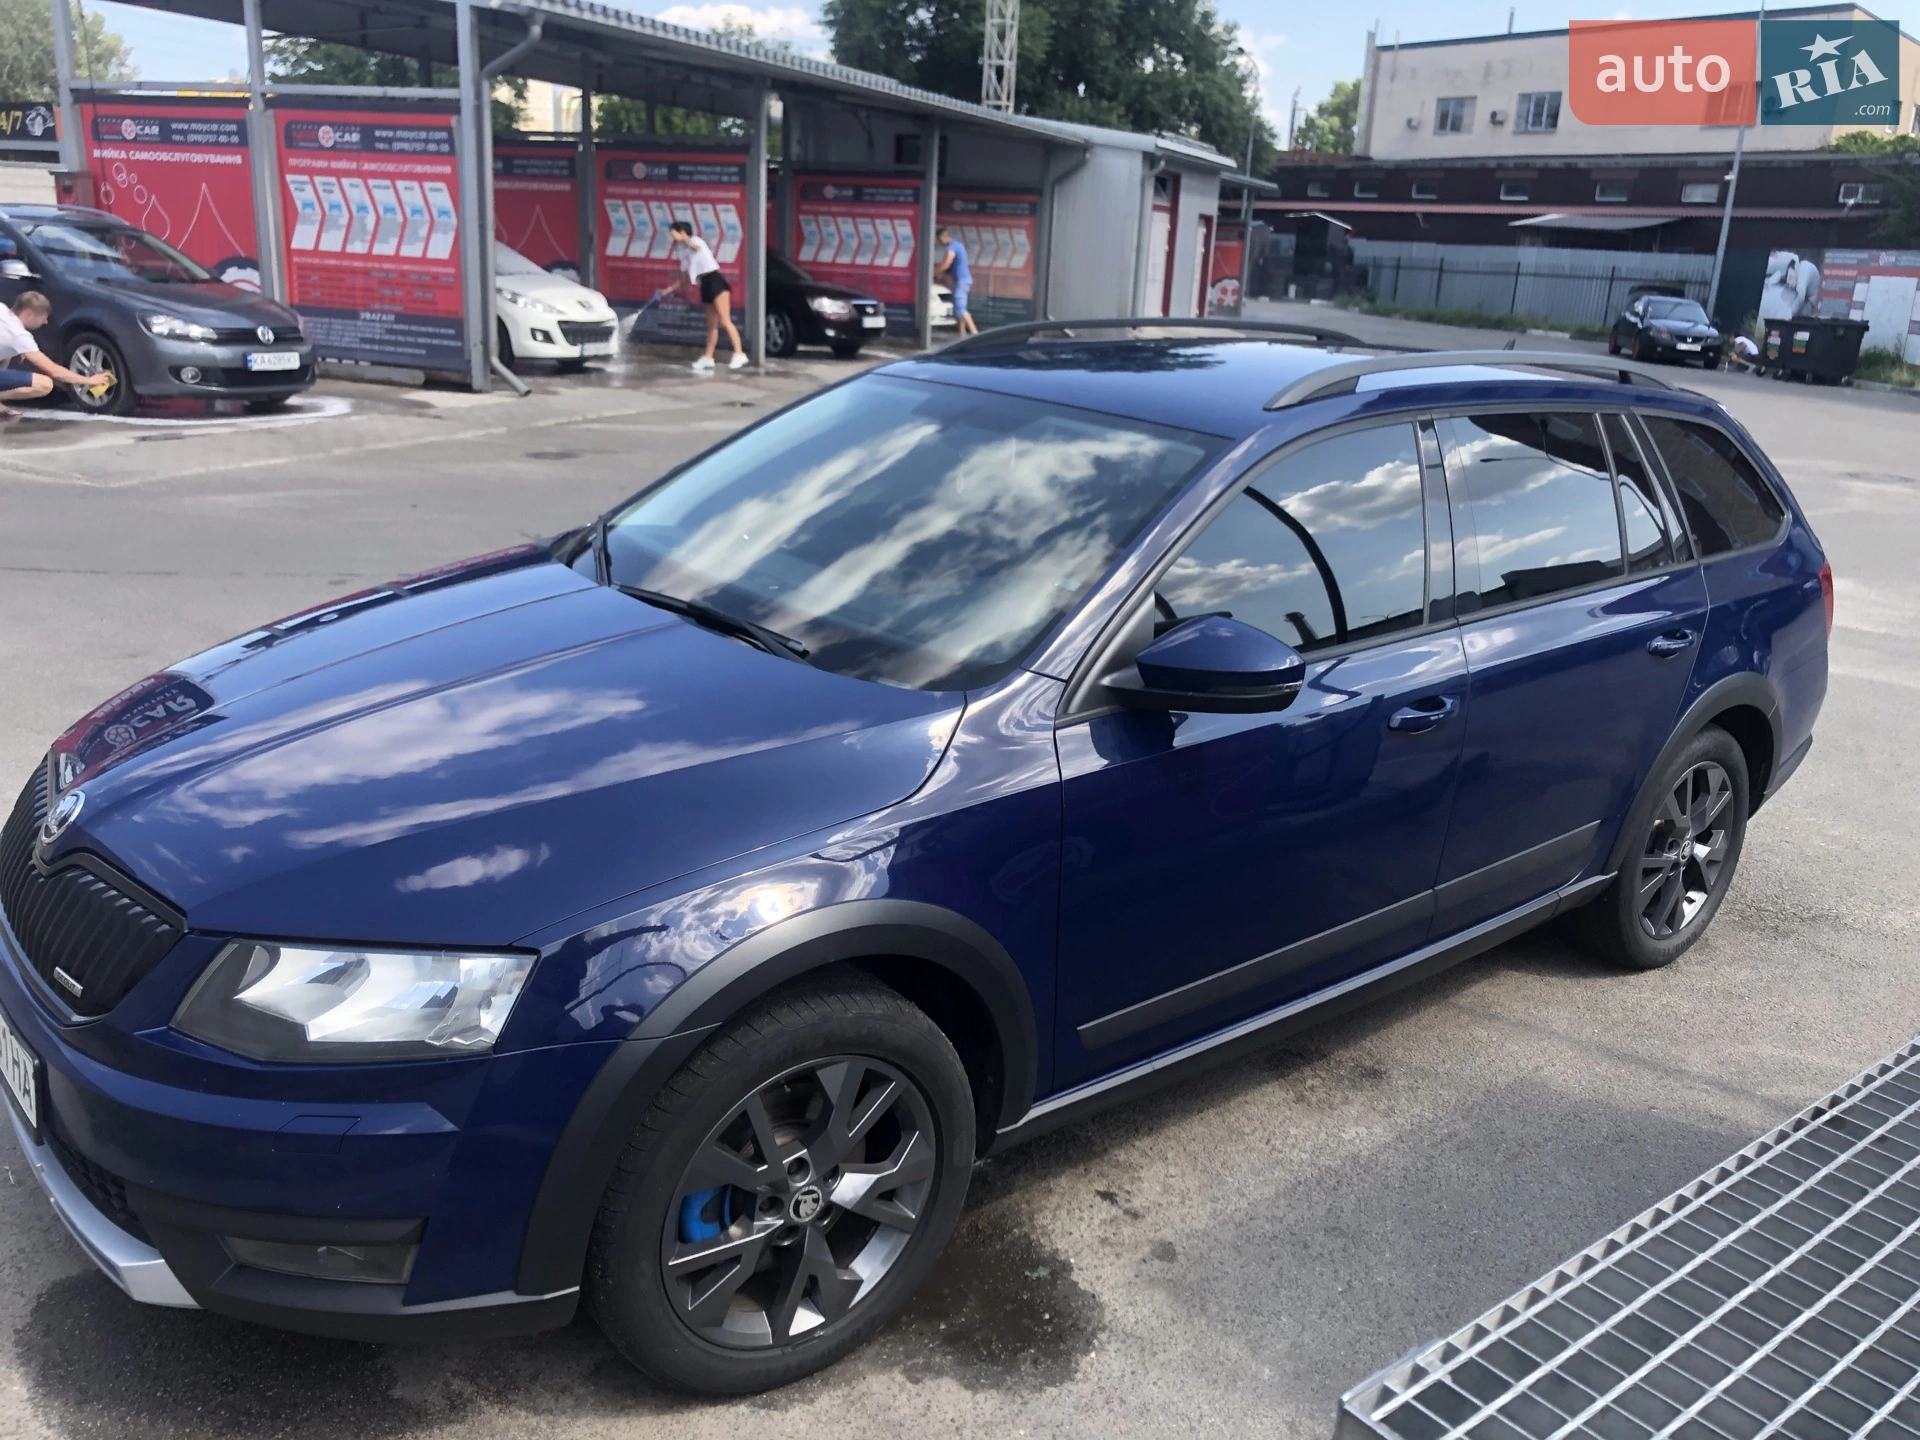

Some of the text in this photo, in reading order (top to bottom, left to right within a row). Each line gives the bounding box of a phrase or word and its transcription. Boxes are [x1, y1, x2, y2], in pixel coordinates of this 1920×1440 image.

[136, 125, 160, 136] CAR
[334, 132, 361, 143] CAR
[93, 148, 243, 165] МИЙКА САМООБСЛУГОВУВАННЯ
